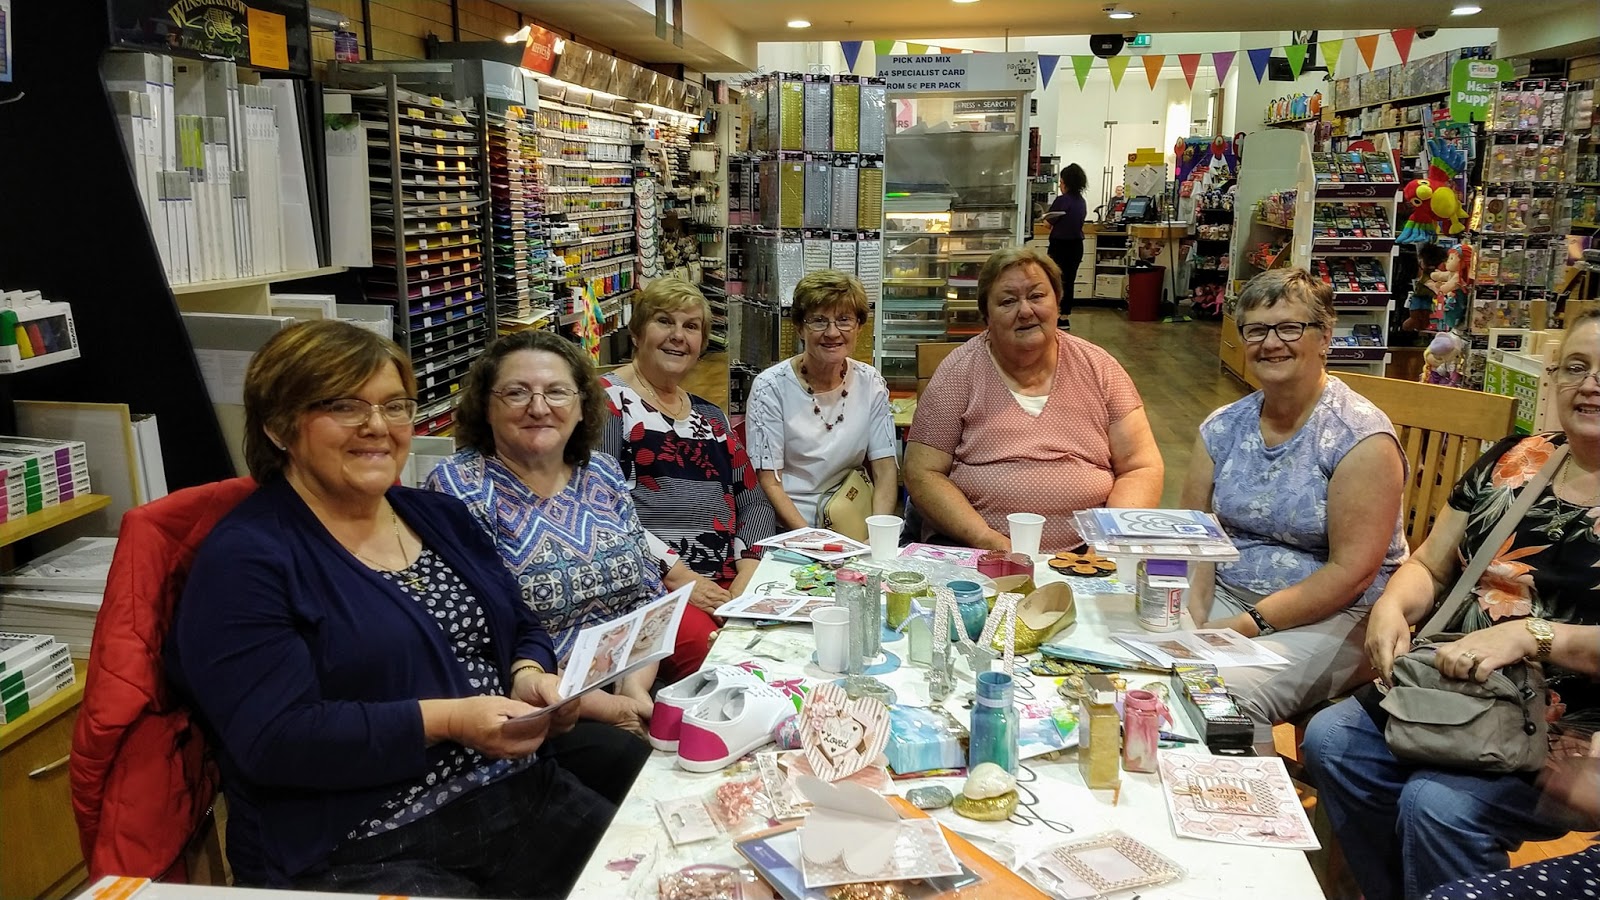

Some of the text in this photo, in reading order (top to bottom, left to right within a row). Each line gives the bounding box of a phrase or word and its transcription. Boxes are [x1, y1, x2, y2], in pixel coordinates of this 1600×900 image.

[893, 56, 913, 64] PICK
[891, 69, 940, 77] SPECIALIST
[886, 82, 905, 90] ROM
[938, 81, 961, 89] PACK
[1457, 92, 1488, 106] Pupp
[896, 120, 909, 128] RS
[68, 318, 78, 348] reeves
